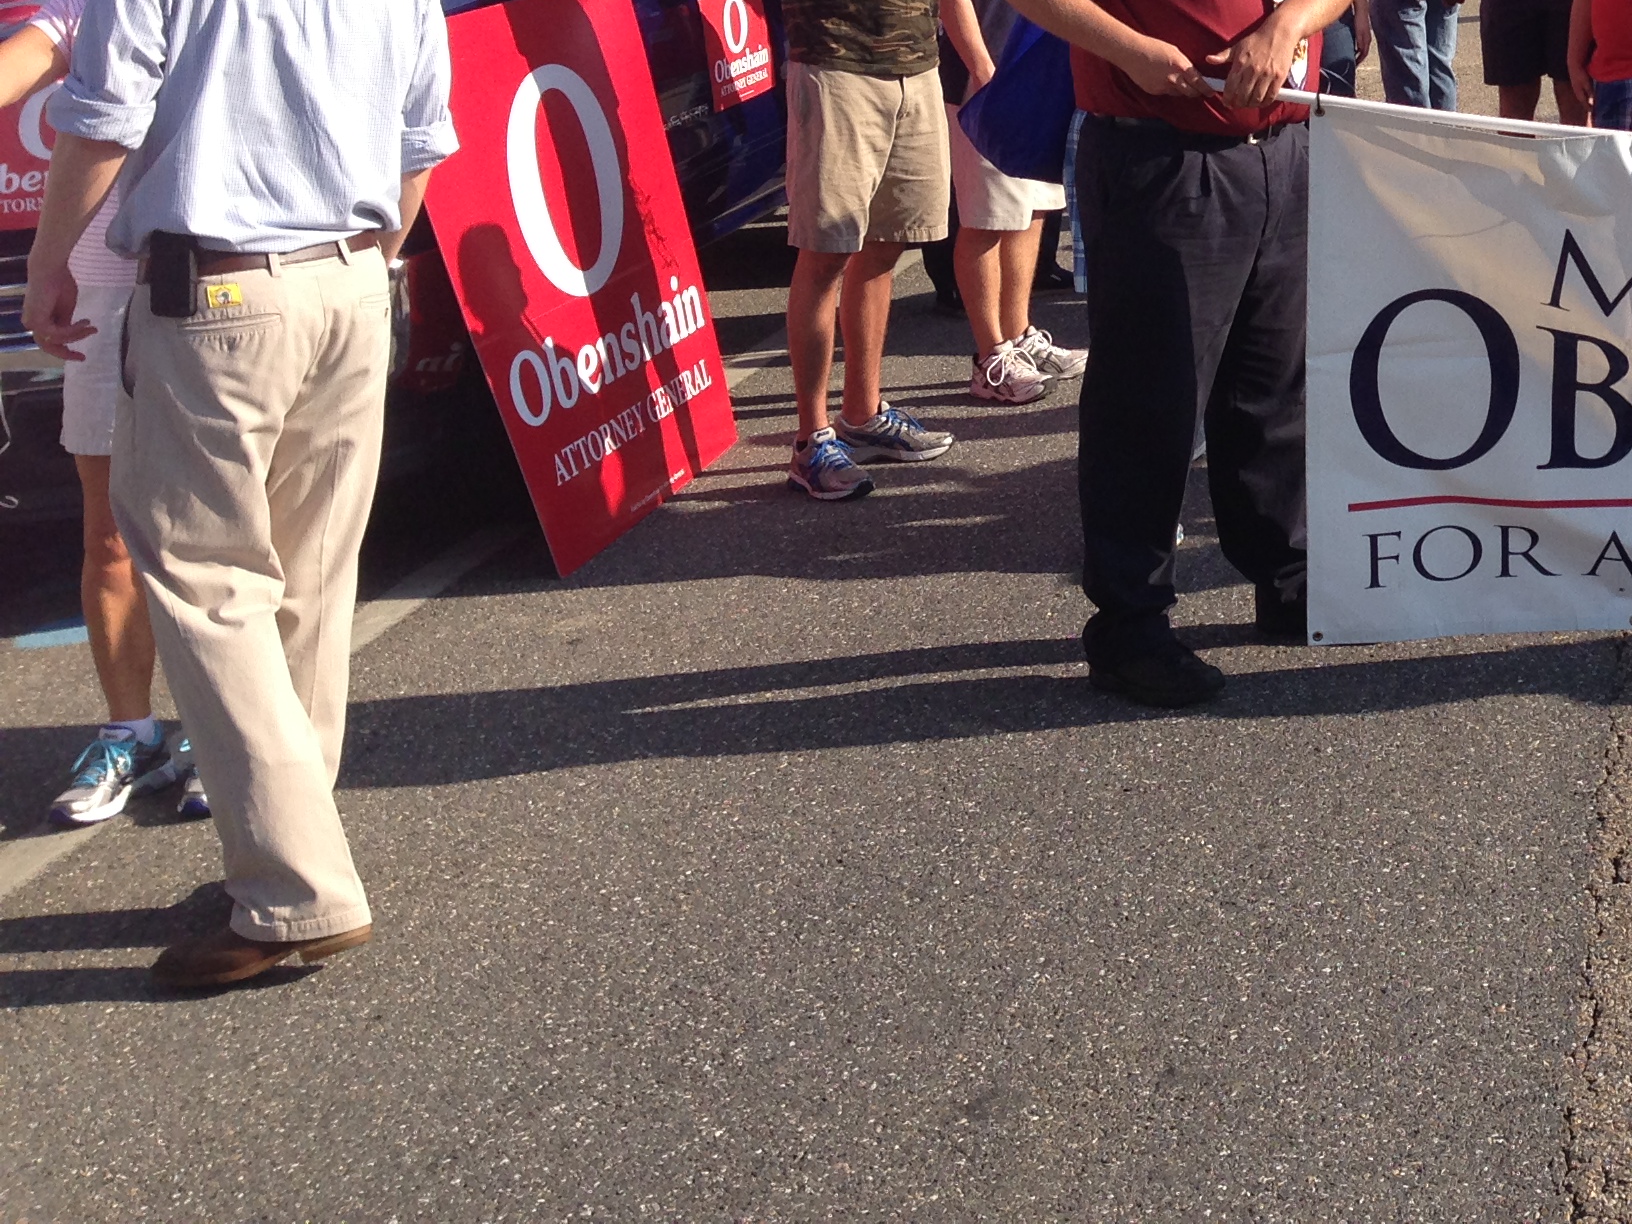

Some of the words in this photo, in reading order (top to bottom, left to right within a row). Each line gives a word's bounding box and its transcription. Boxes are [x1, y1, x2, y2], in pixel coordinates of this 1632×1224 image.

[714, 44, 770, 84] Obenshain
[506, 63, 625, 298] O
[509, 275, 706, 428] Obenshain
[553, 399, 648, 486] ATTORNEY
[646, 358, 712, 424] GENERAL
[1364, 523, 1562, 590] FOR
